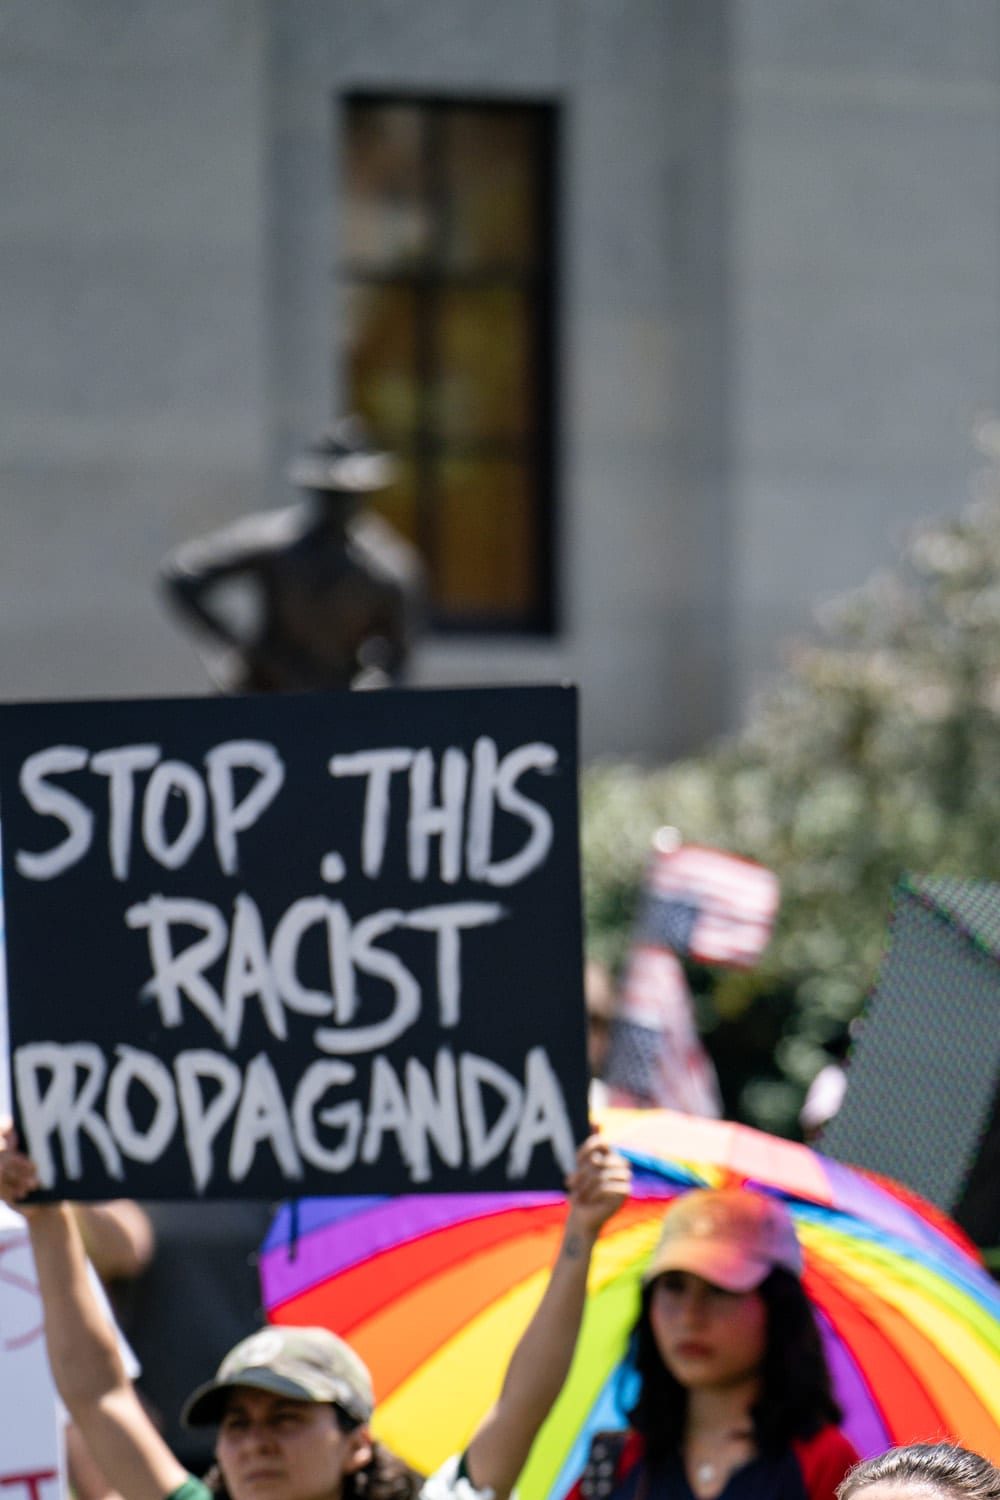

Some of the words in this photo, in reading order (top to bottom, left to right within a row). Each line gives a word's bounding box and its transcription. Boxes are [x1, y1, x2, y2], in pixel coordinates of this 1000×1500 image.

[15, 739, 285, 882] STOP
[126, 892, 506, 1054] RACIST
[13, 1041, 578, 1192] PROPAGANDA
